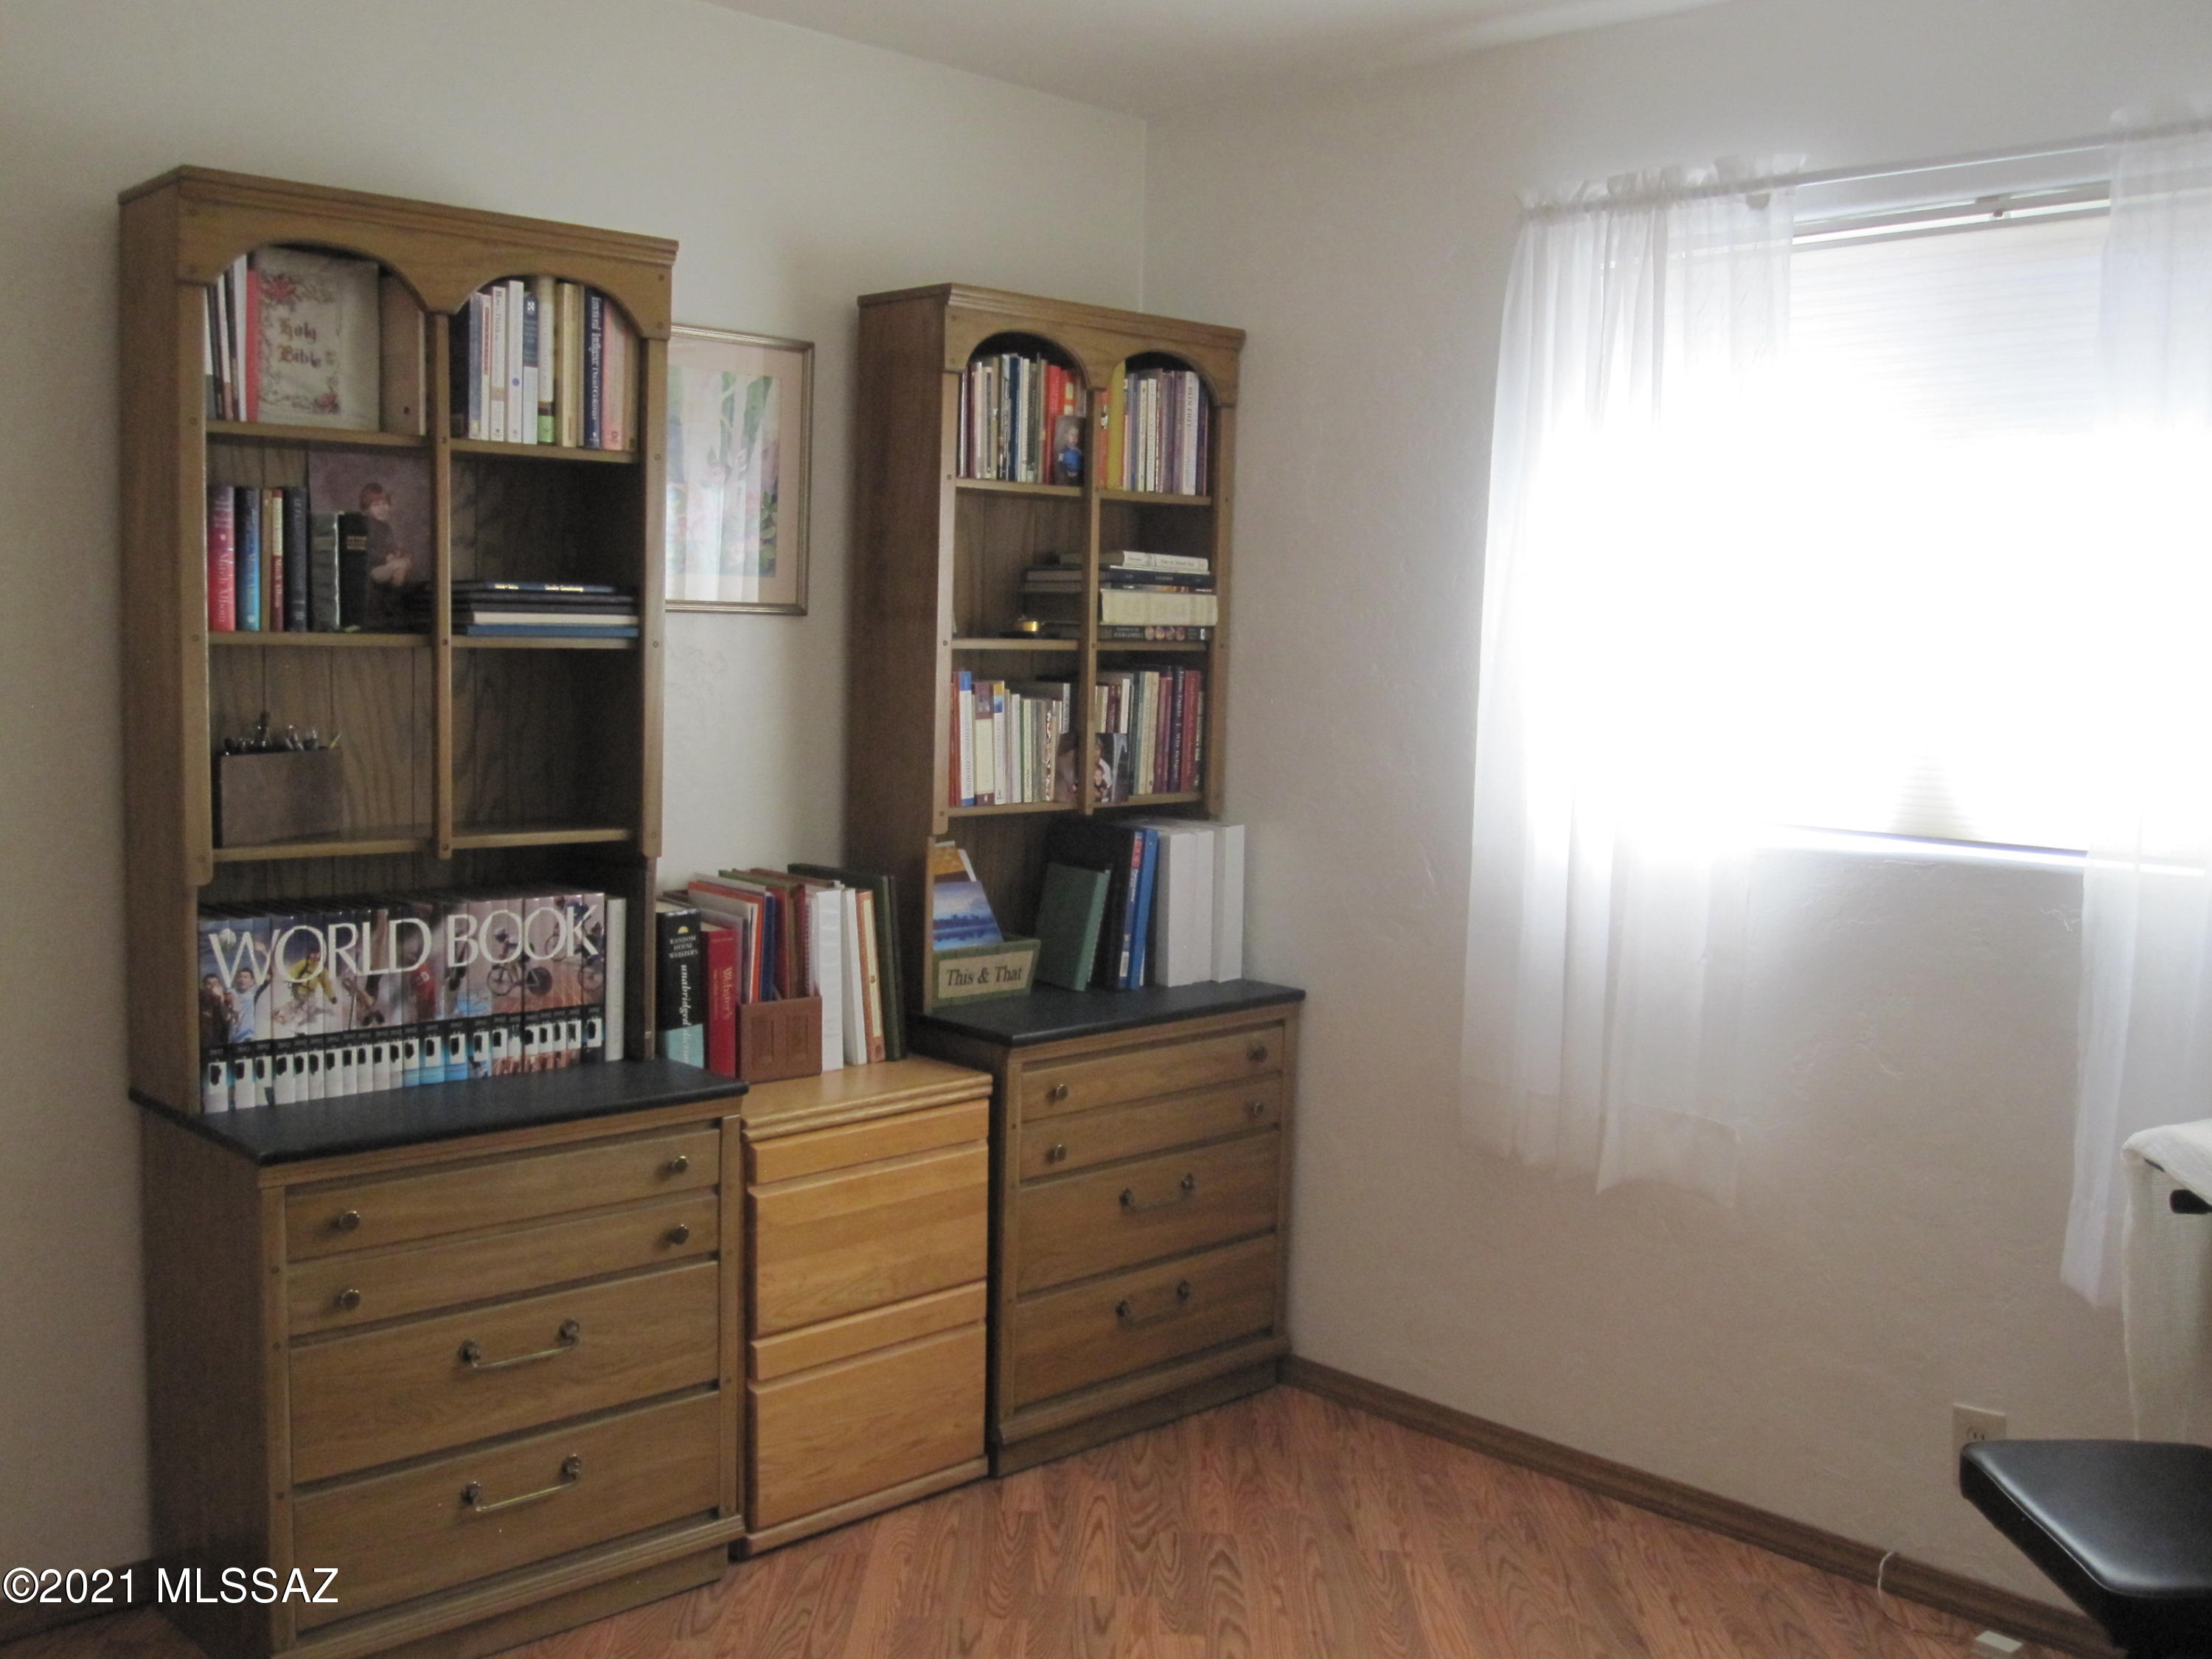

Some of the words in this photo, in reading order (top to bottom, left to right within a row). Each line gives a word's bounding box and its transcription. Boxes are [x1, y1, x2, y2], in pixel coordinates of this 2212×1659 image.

[591, 296, 602, 330] Emotional
[279, 317, 317, 345] Holy
[278, 344, 322, 369] Bible
[588, 333, 601, 366] Intelligence
[218, 552, 229, 585] Mitch
[218, 588, 229, 623] Albom
[209, 917, 432, 989] WORLD
[447, 904, 601, 968] BOOK
[669, 935, 697, 945] RANDOM
[673, 942, 692, 950] HOUSE
[947, 968, 974, 987] This
[978, 967, 990, 984] &
[995, 965, 1023, 983] That
[680, 964, 692, 1026] unabridged
[723, 967, 733, 1020] Webster's
